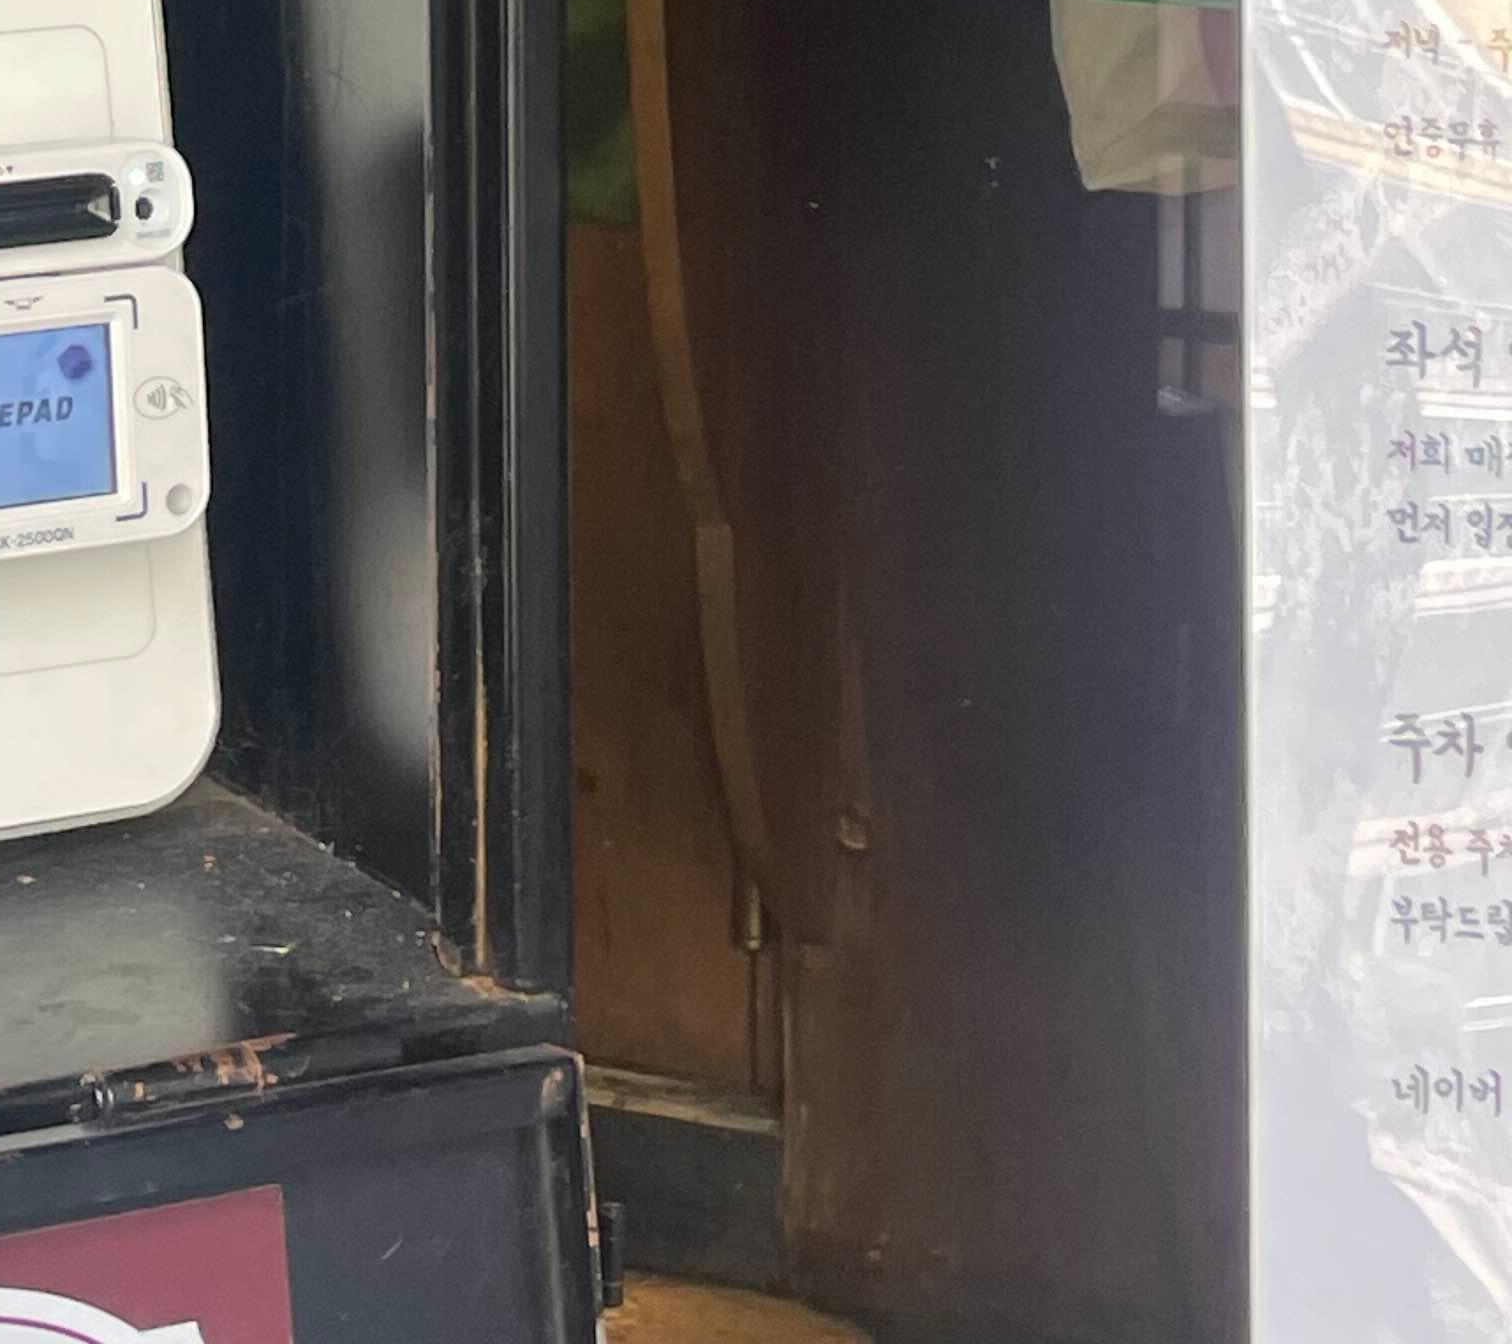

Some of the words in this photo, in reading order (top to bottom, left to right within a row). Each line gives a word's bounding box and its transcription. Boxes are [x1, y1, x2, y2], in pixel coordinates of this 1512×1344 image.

[1383, 19, 1441, 65] 저녁
[1383, 114, 1501, 162] 연중무휴
[1385, 319, 1482, 389] 좌석
[1386, 428, 1450, 476] 저희
[1464, 433, 1512, 479] 매
[1386, 500, 1451, 545] 먼저
[1388, 711, 1485, 785] 주차
[1389, 820, 1454, 869] 전용
[1391, 1062, 1503, 1119] 네이버
